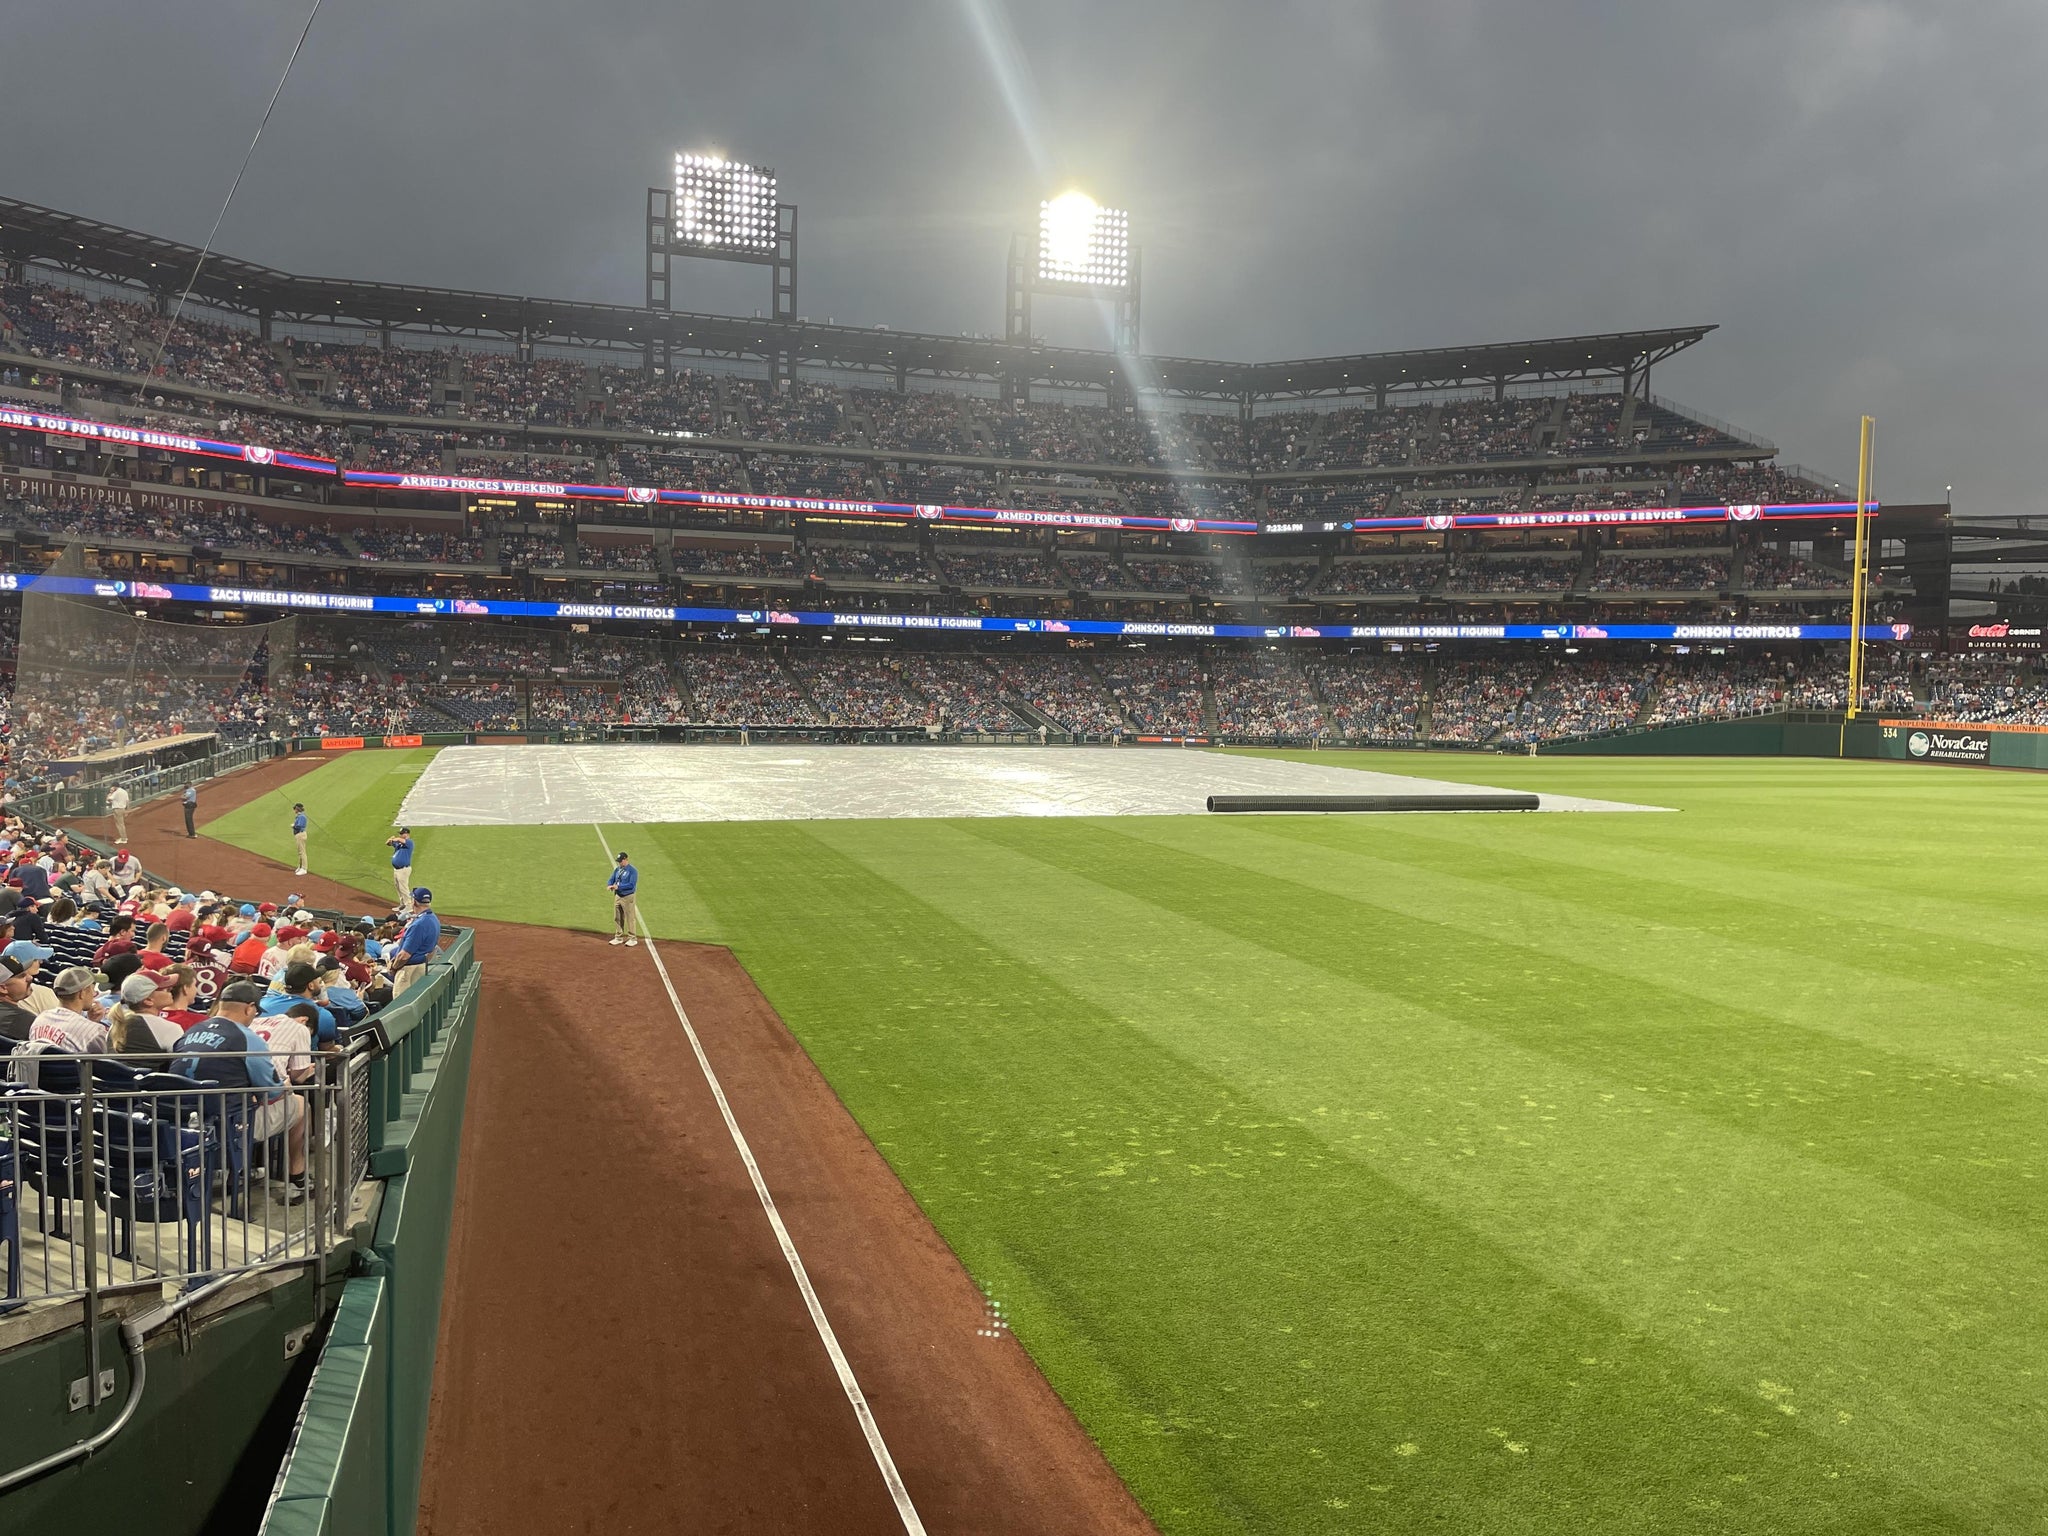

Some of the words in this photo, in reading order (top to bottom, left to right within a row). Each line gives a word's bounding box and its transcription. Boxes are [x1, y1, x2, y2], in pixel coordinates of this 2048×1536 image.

[37, 418, 67, 431] YOU
[71, 423, 99, 436] FOR
[103, 426, 139, 442] YOUR
[399, 475, 448, 491] ARMED
[450, 479, 500, 494] FORCES
[502, 482, 567, 498] WEEKEND
[700, 494, 740, 506] THANK
[743, 497, 766, 507] YOU
[770, 499, 792, 508] FOR
[796, 500, 825, 510] YOUR
[828, 502, 877, 513] SERVICE.
[995, 511, 1033, 522] ARMED
[1034, 513, 1072, 524] FORCES
[1074, 515, 1123, 527] WEEKEND
[1497, 515, 1537, 526] THANK
[1540, 513, 1564, 524] YOU
[1567, 513, 1591, 523] FOR
[1594, 511, 1627, 523] YOUR
[210, 587, 240, 602] ZACK
[242, 590, 288, 605] WHEELER
[290, 593, 327, 607] BOBBLE
[328, 596, 373, 609] FIGURINE
[556, 604, 613, 618] JOHNSON
[615, 606, 675, 620] CONTROLS
[833, 614, 859, 626] ZACK
[860, 615, 904, 627] WHEELER
[904, 617, 940, 628] BOBBLE
[941, 618, 982, 629] FIGURINE
[1121, 623, 1166, 635] JOHNSON
[1167, 624, 1215, 636] CONTROLS
[1352, 626, 1377, 637] ZACK
[1378, 626, 1421, 637] WHEELER
[1422, 626, 1458, 637] BOBBLE
[1460, 626, 1505, 637] FIGURINE
[1672, 626, 1731, 639] JOHNSON
[1733, 626, 1801, 639] CONTROLS
[1968, 641, 2007, 649] BURGERS
[1883, 727, 1898, 738] 334
[1995, 725, 2041, 733] ASPLUNDH
[1930, 734, 1988, 751] NovaCare
[1930, 750, 1985, 760] REHABILITATION
[196, 970, 218, 998] 8
[33, 1025, 66, 1046] TURNER
[184, 1031, 226, 1049] HARPER
